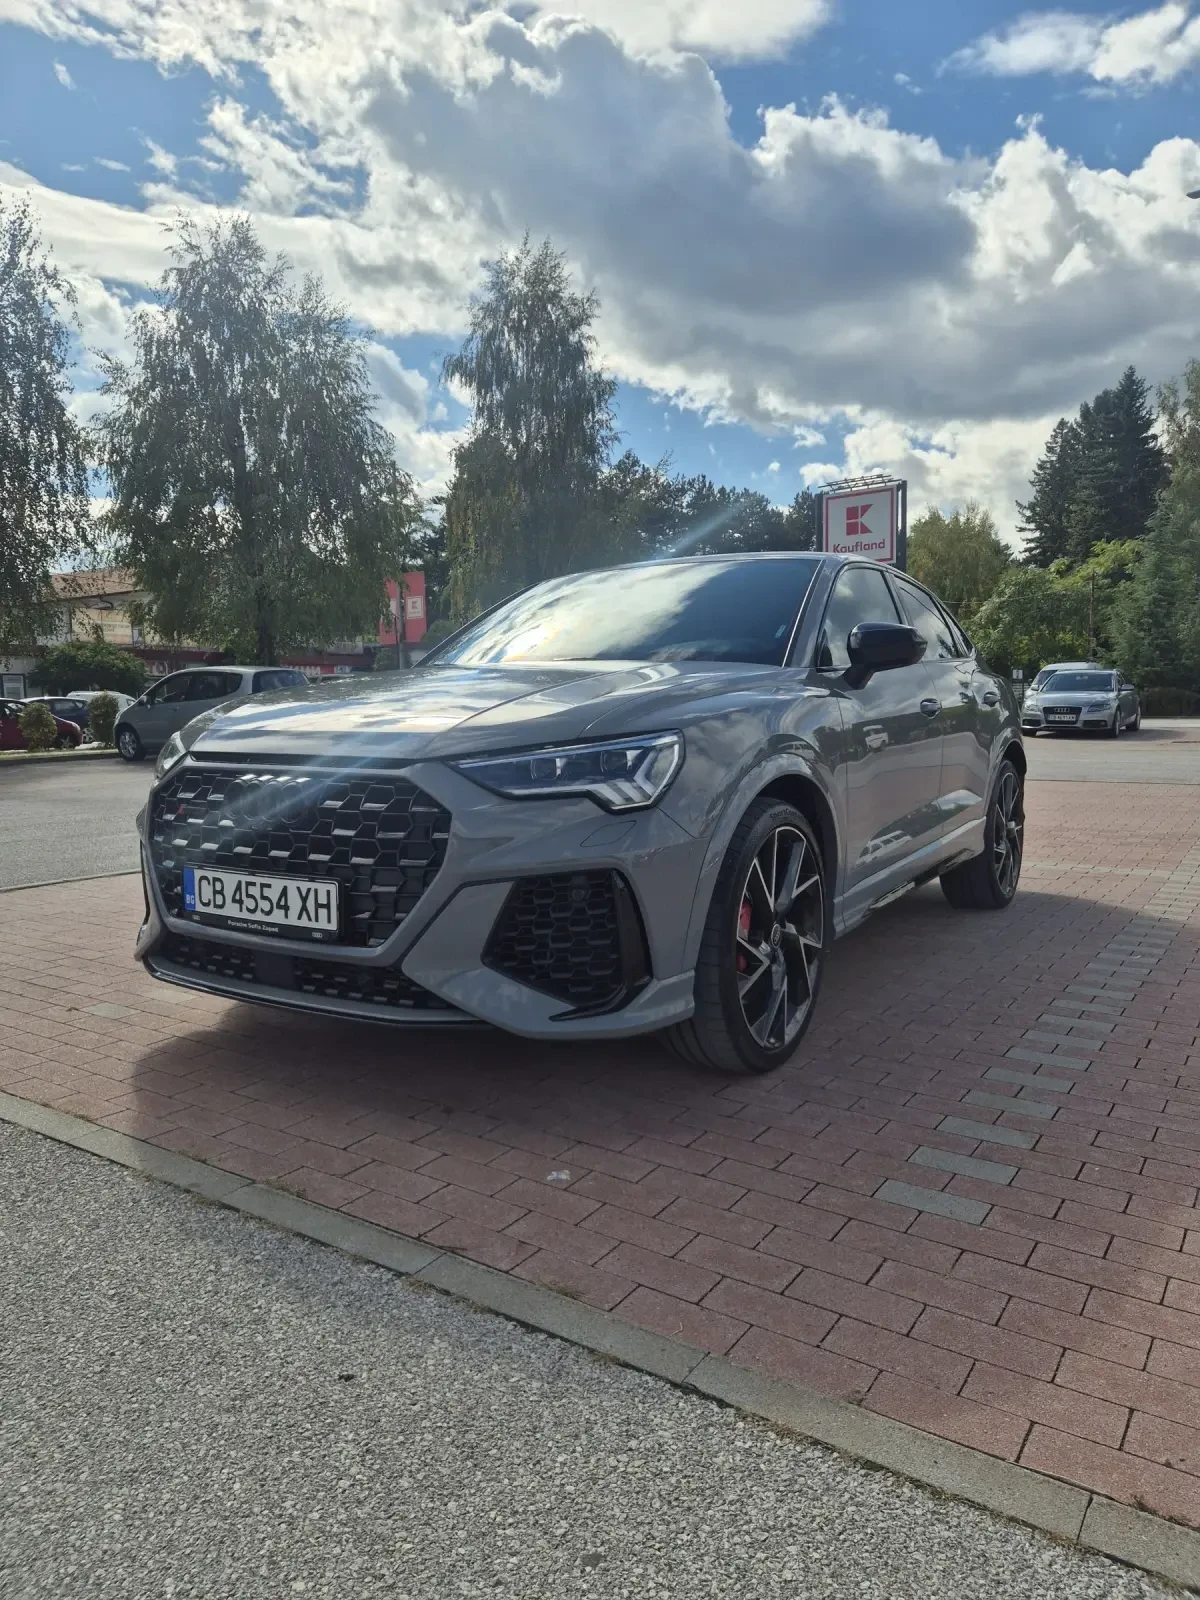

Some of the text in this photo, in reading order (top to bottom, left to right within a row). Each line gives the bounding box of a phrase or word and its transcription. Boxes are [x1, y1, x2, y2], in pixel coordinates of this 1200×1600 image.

[833, 539, 885, 553] Kaufland
[186, 894, 195, 905] BG
[198, 875, 332, 924] CB 4554 XH
